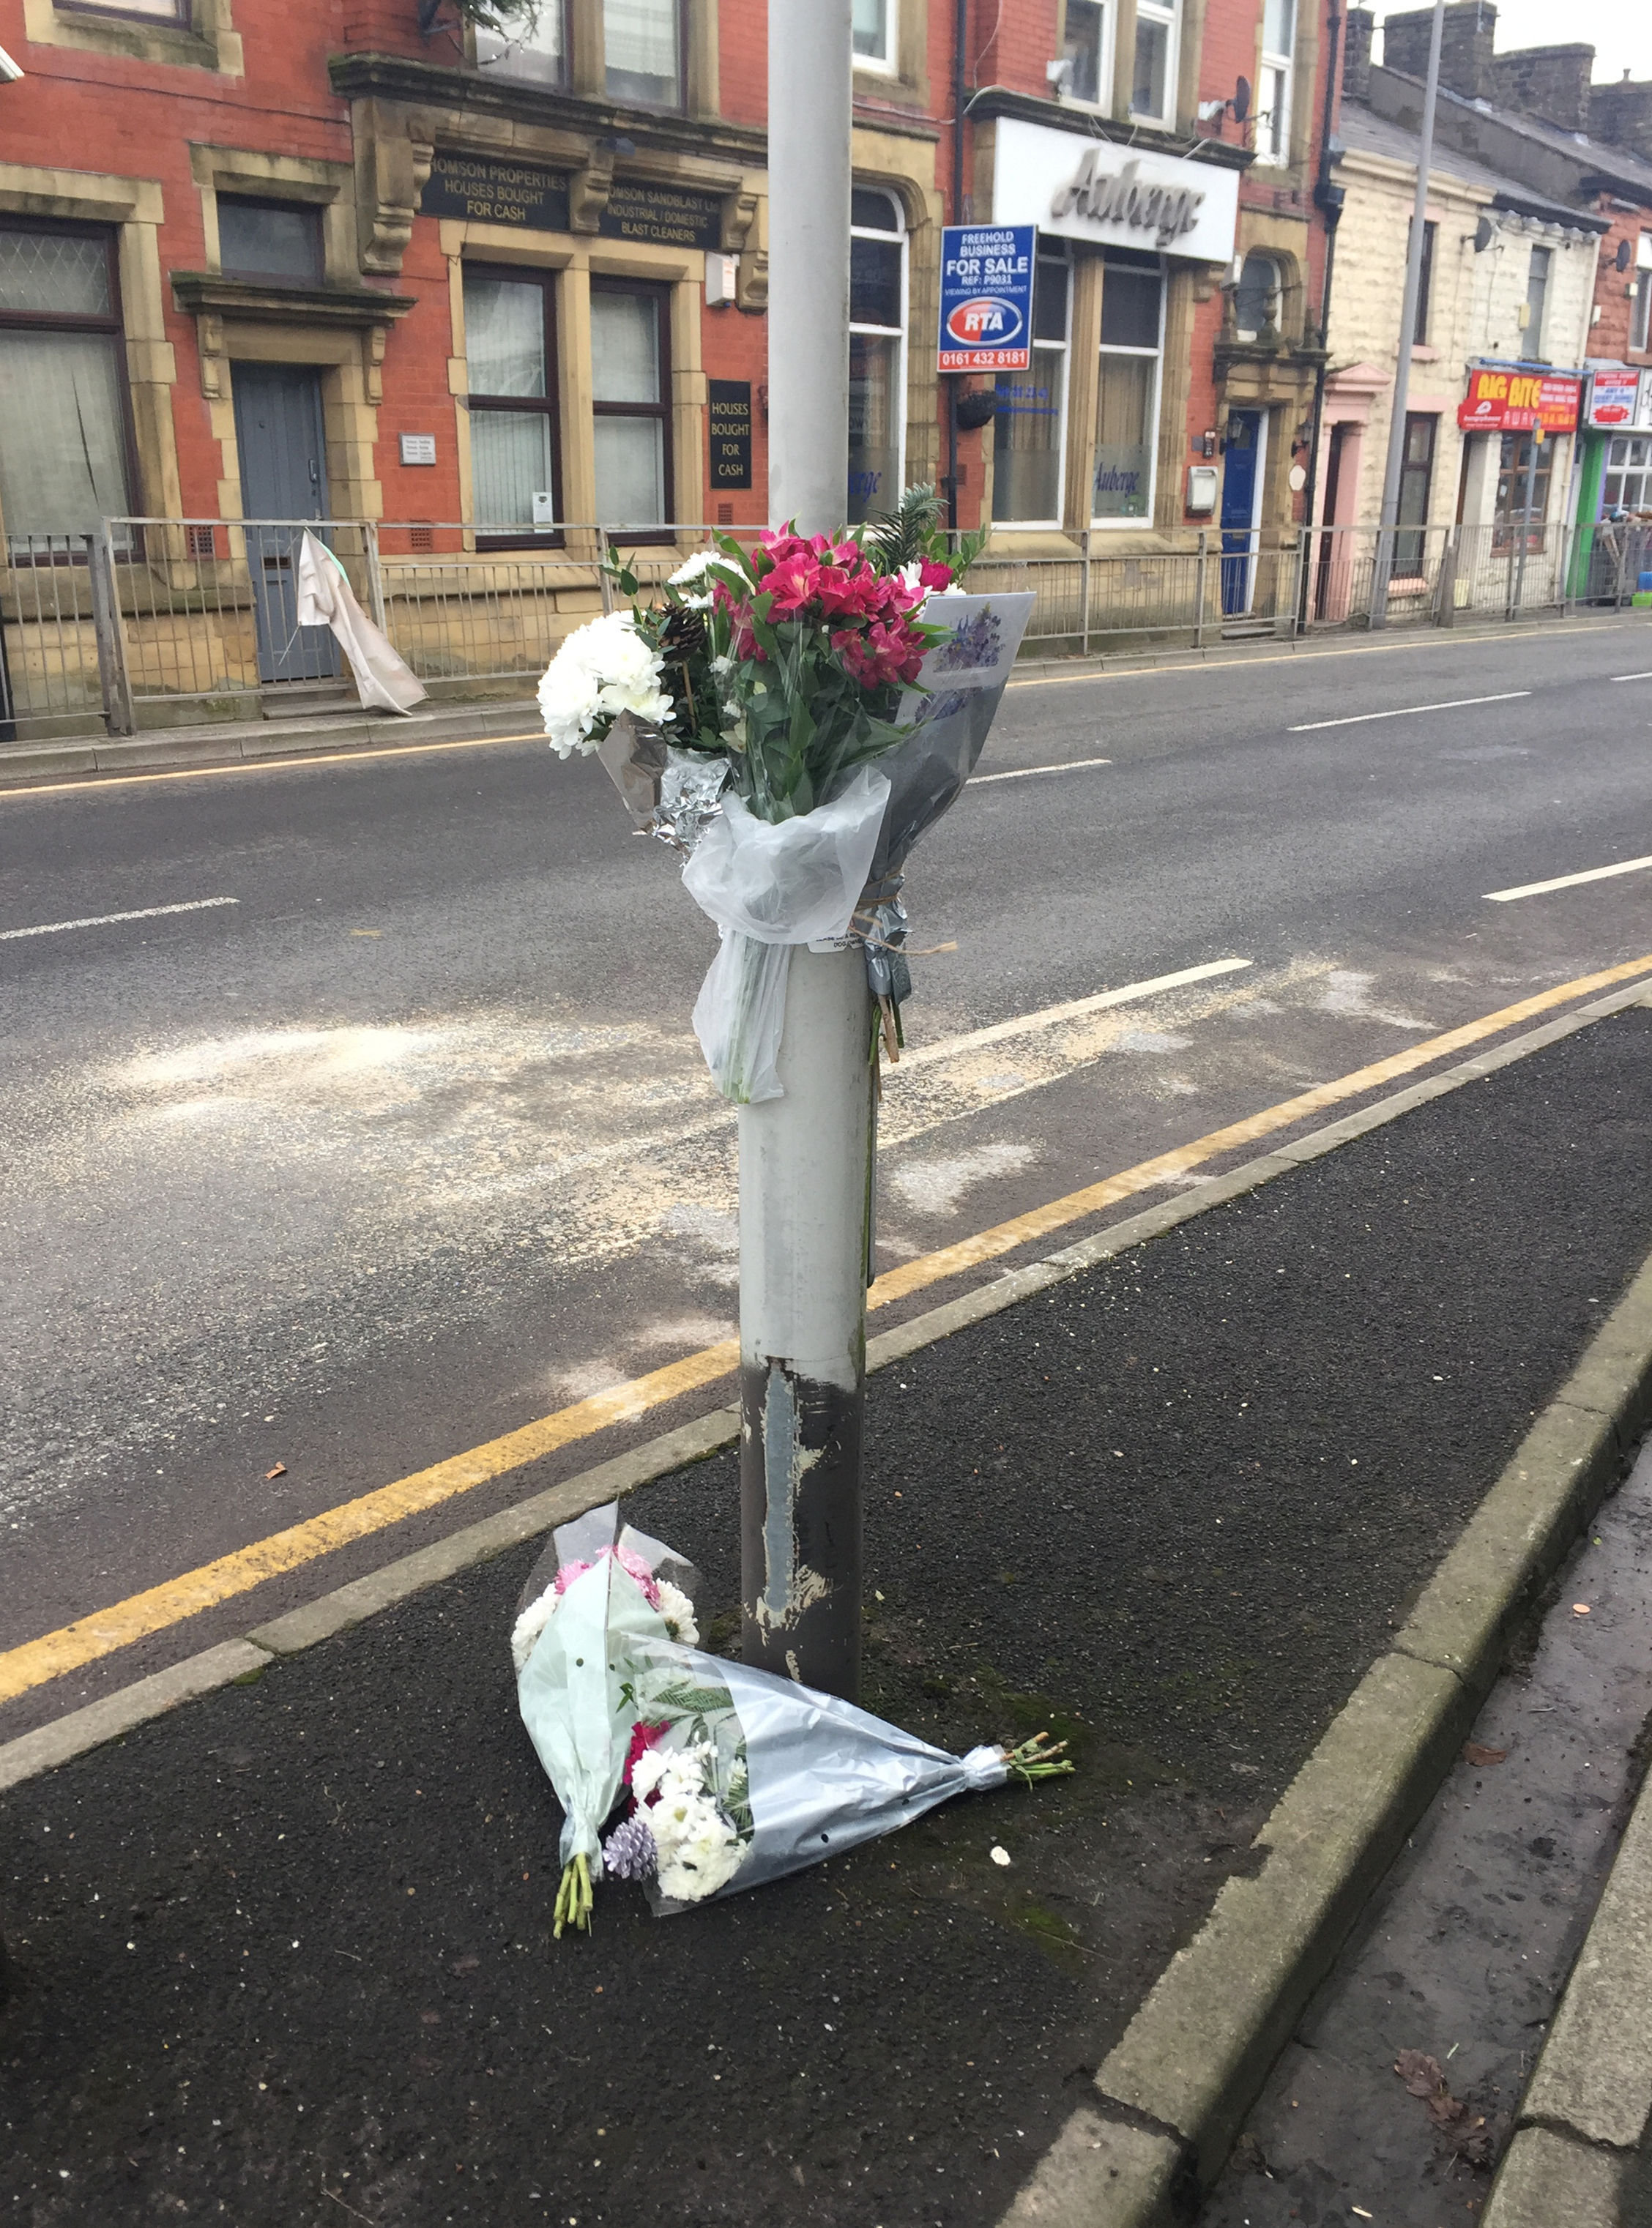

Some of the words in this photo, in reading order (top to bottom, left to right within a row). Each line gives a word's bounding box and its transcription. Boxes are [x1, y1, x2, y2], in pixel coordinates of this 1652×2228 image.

[431, 157, 486, 179] HOMSON
[489, 165, 568, 192] PROPERTIES
[444, 179, 494, 198] HOUSES
[497, 186, 545, 205] BOUGHT
[608, 185, 645, 202] OMSON
[647, 190, 703, 211] SANDBLAST
[466, 200, 492, 217] FOR
[494, 204, 527, 220] CASH
[607, 203, 658, 221] INDUSTRIAL
[664, 212, 710, 228] DOMESTIC
[621, 221, 649, 236] BLAST
[651, 225, 696, 242] CLEANERS
[961, 231, 1014, 245] FREEHOLD
[960, 244, 1016, 257] BUSINESS
[946, 258, 981, 276] FOR
[984, 256, 1029, 274] SALE
[961, 275, 982, 286] REF:
[983, 274, 1012, 285] P9031
[945, 287, 972, 296] VIEWING
[972, 286, 981, 294] BY
[981, 285, 1027, 294] APPOINTMENT
[964, 312, 1004, 332] RTA
[942, 353, 970, 365] 0161
[972, 352, 995, 365] 432
[997, 351, 1025, 364] 8181
[1477, 373, 1508, 400] BIG
[1508, 376, 1543, 409] BITE
[712, 402, 748, 415] HOUSES
[711, 422, 750, 436] BOUGHT
[722, 443, 740, 455] FOR
[718, 463, 744, 476] CASH
